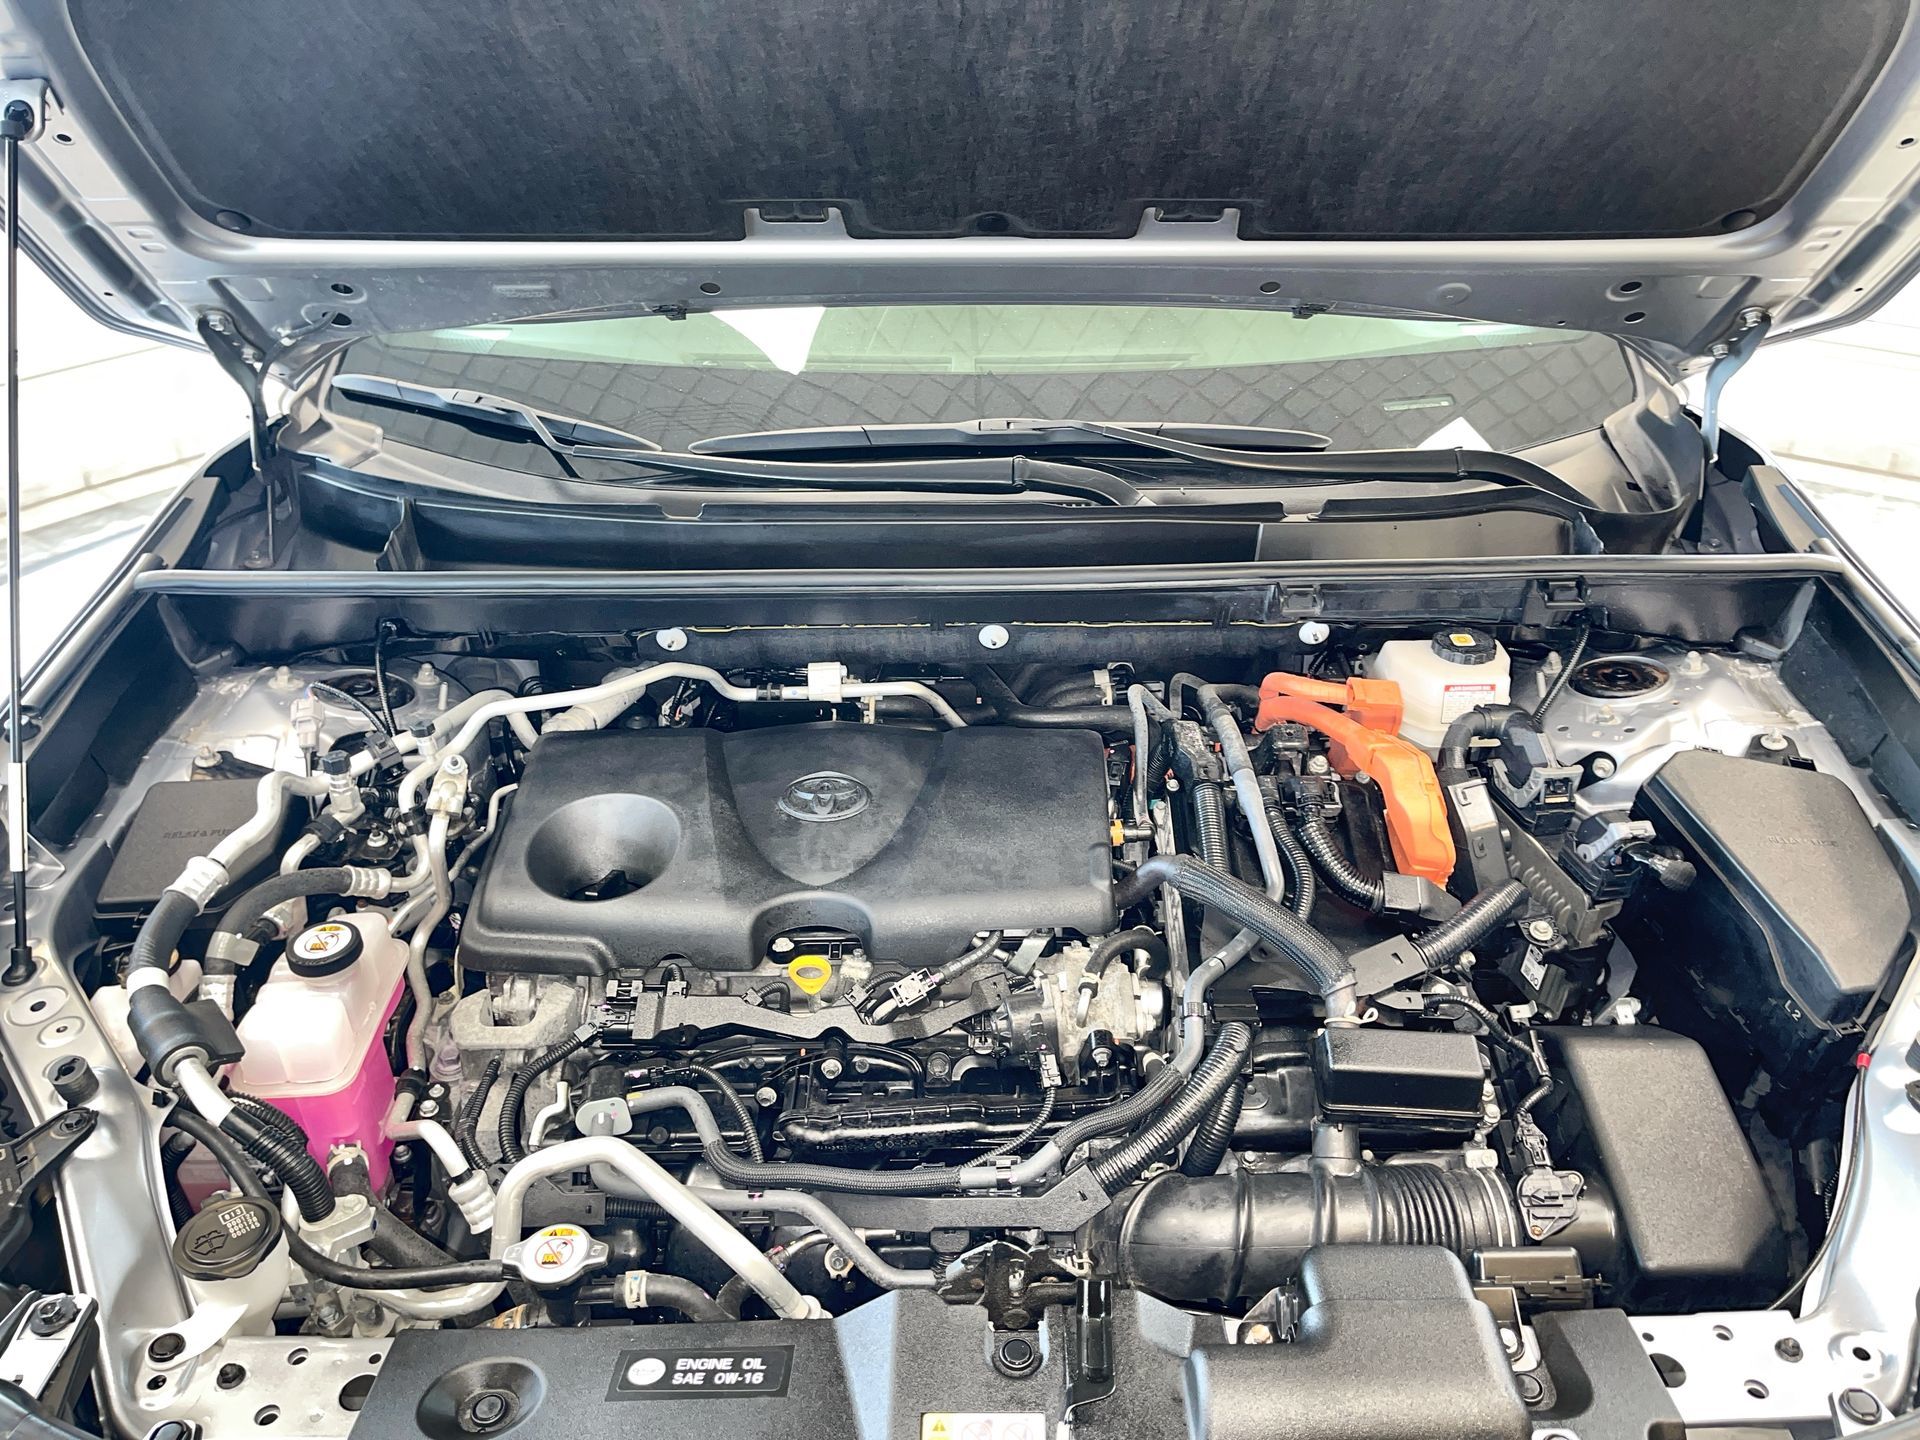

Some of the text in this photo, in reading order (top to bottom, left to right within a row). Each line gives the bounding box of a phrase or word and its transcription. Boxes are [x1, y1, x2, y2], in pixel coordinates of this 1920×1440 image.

[675, 1358, 767, 1370] ENGINE OIL
[671, 1372, 706, 1385] SAE
